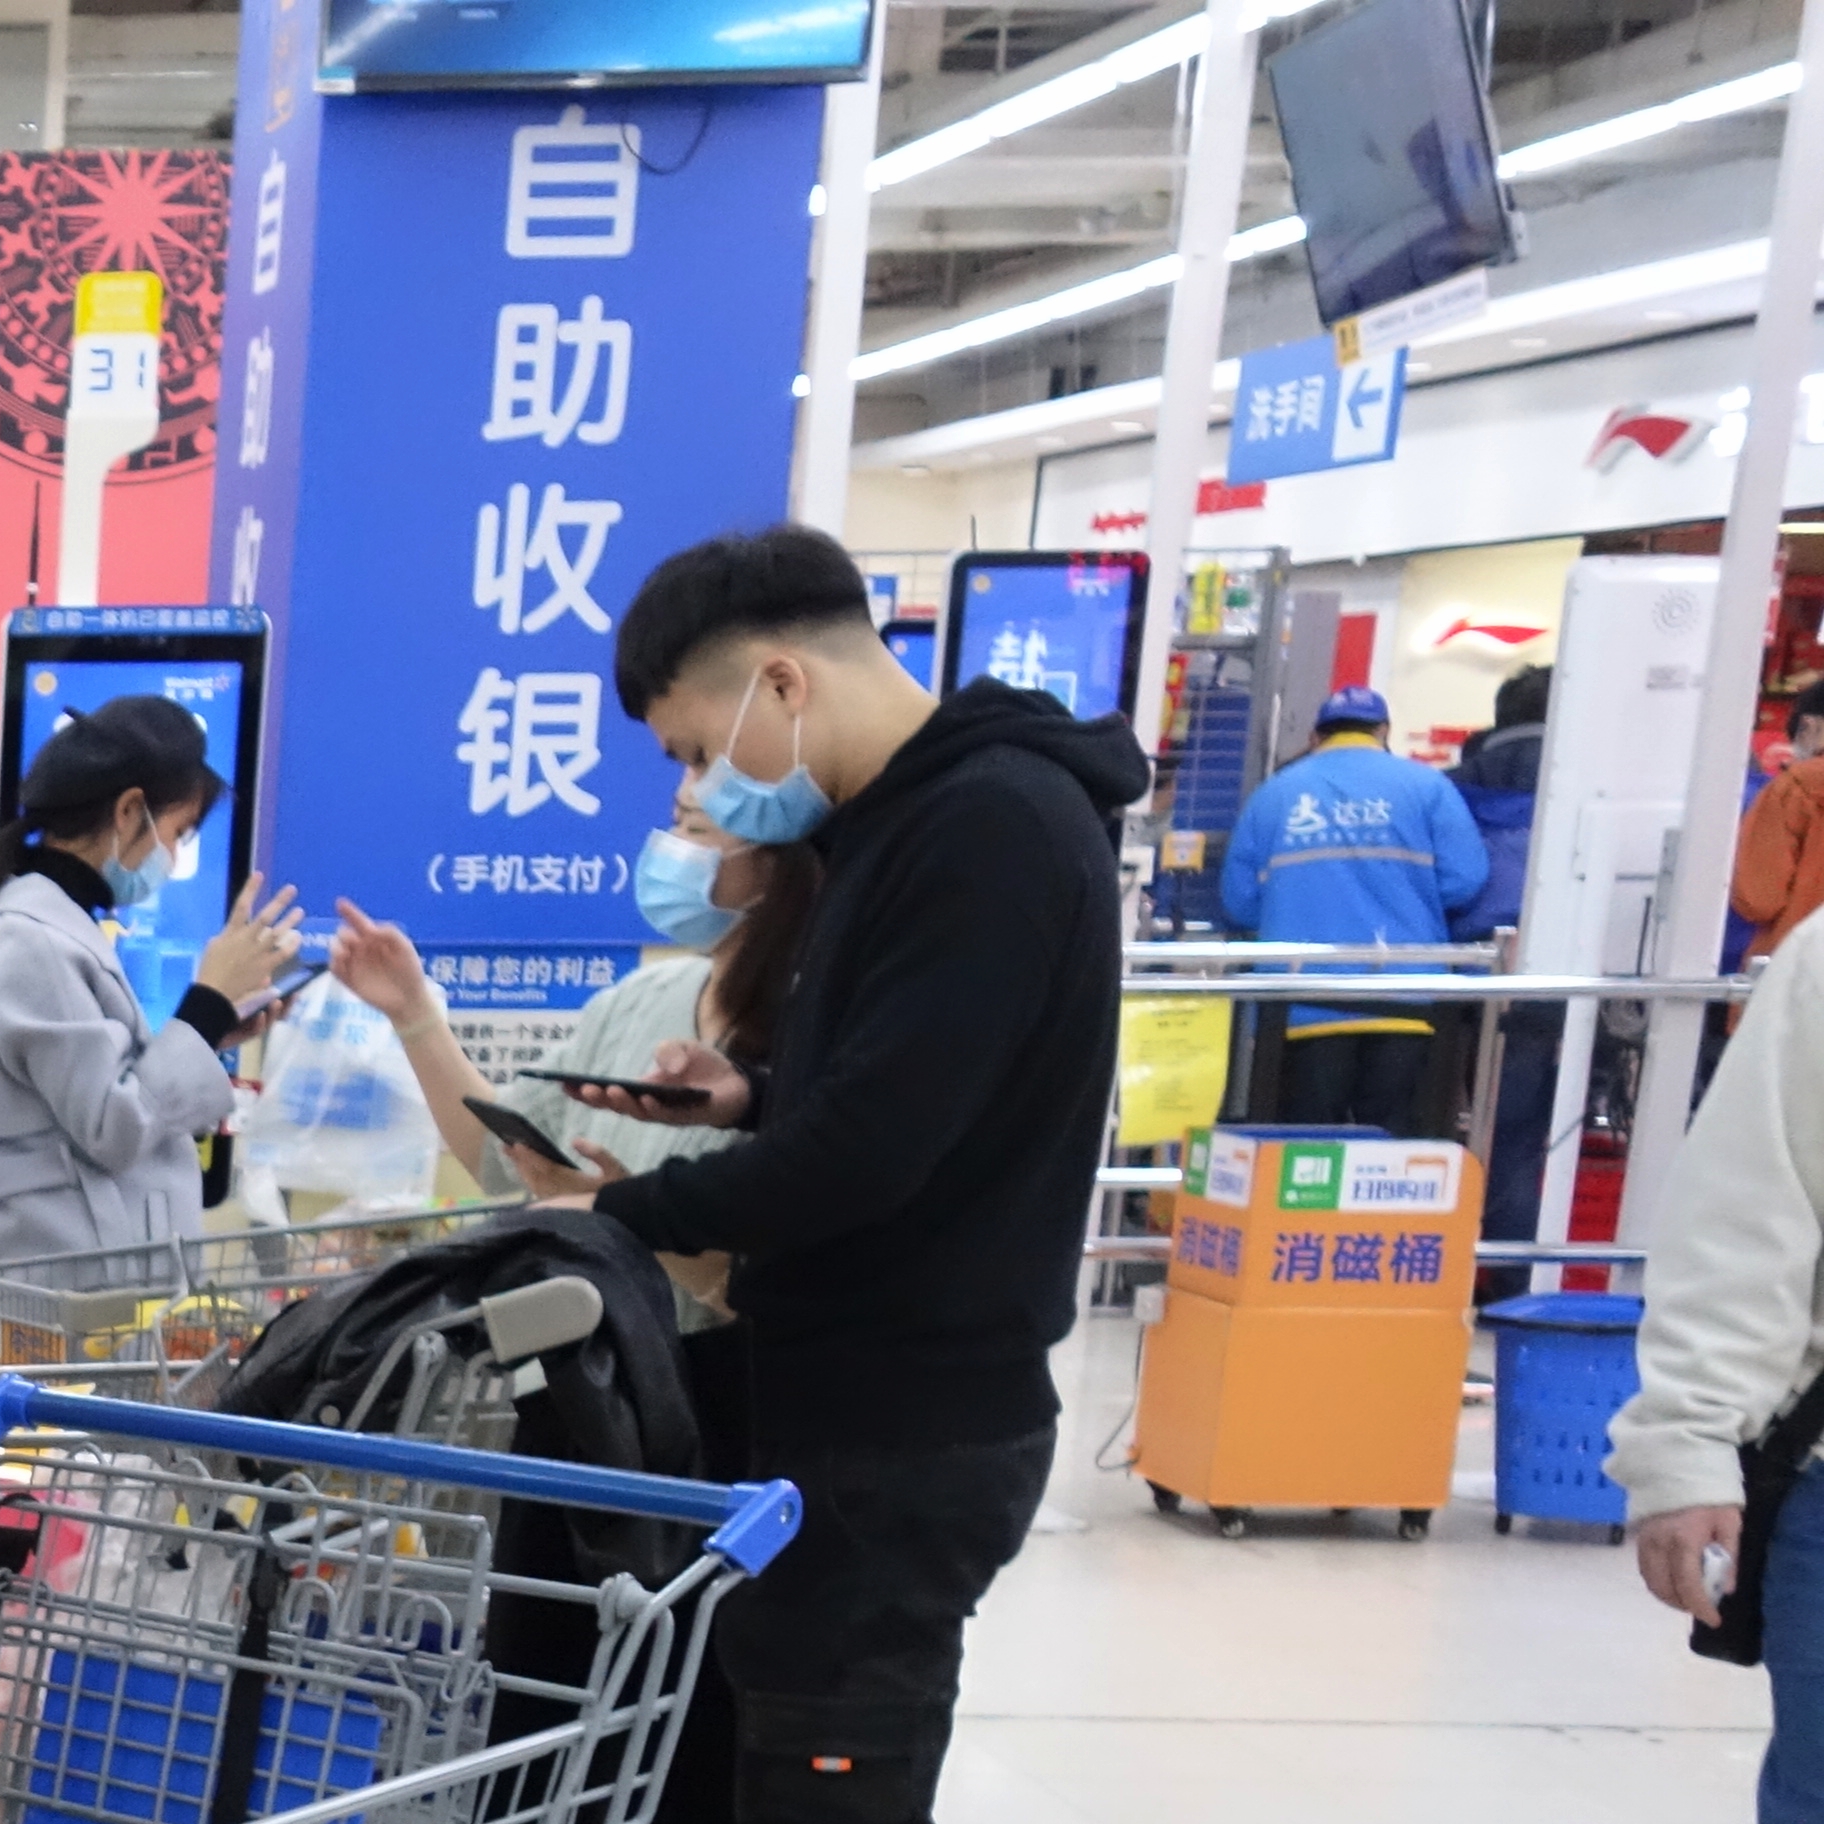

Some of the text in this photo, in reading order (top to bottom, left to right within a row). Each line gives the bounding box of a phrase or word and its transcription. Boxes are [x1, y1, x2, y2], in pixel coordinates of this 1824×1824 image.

[86, 348, 149, 393] 31
[456, 103, 643, 817] 自助收银
[1271, 1231, 1445, 1284] 消磁桶
